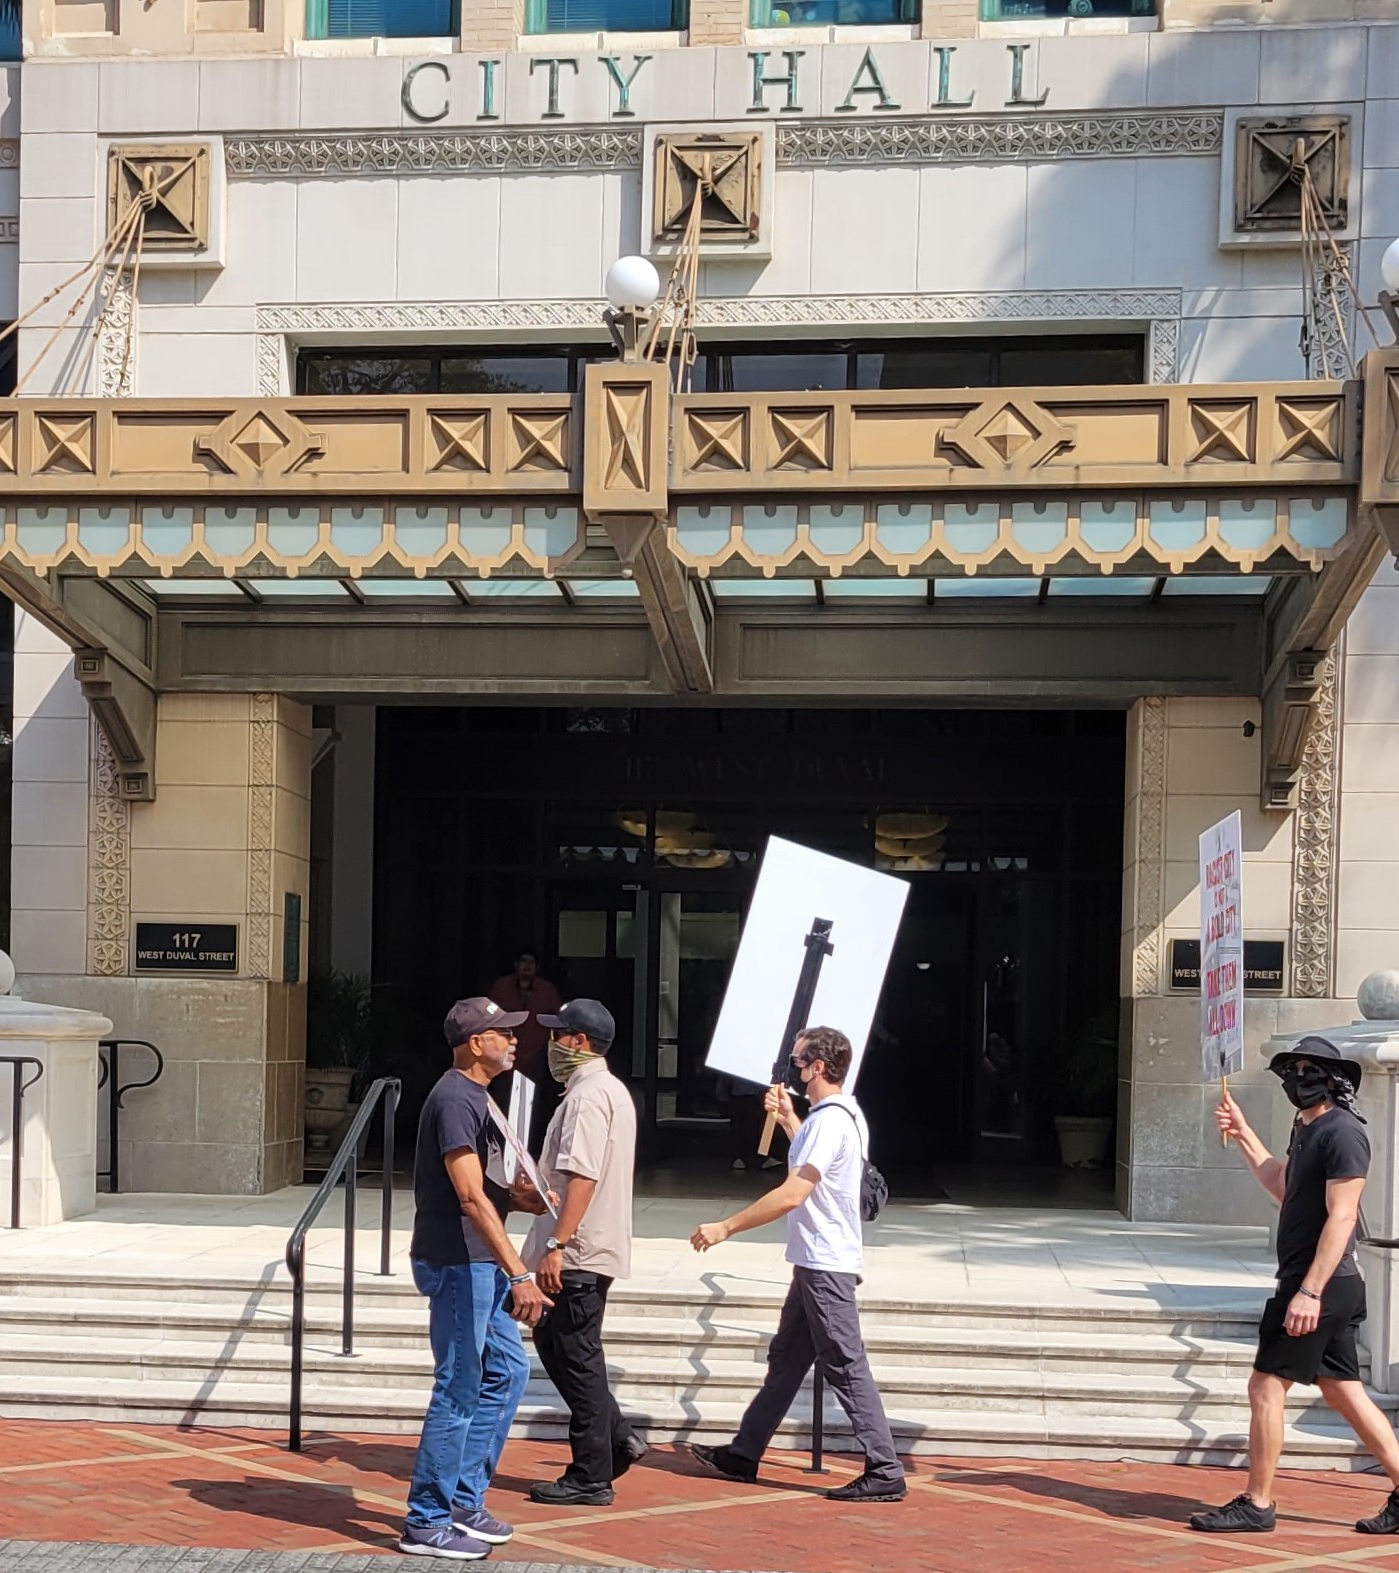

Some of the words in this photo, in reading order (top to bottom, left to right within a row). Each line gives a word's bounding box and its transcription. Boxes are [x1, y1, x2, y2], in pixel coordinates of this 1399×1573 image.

[401, 54, 653, 122] CITY
[747, 43, 1052, 113] HALL
[172, 933, 202, 948] 117
[137, 950, 164, 960] WEST
[166, 951, 197, 960] DUVAL
[198, 952, 235, 961] STREET
